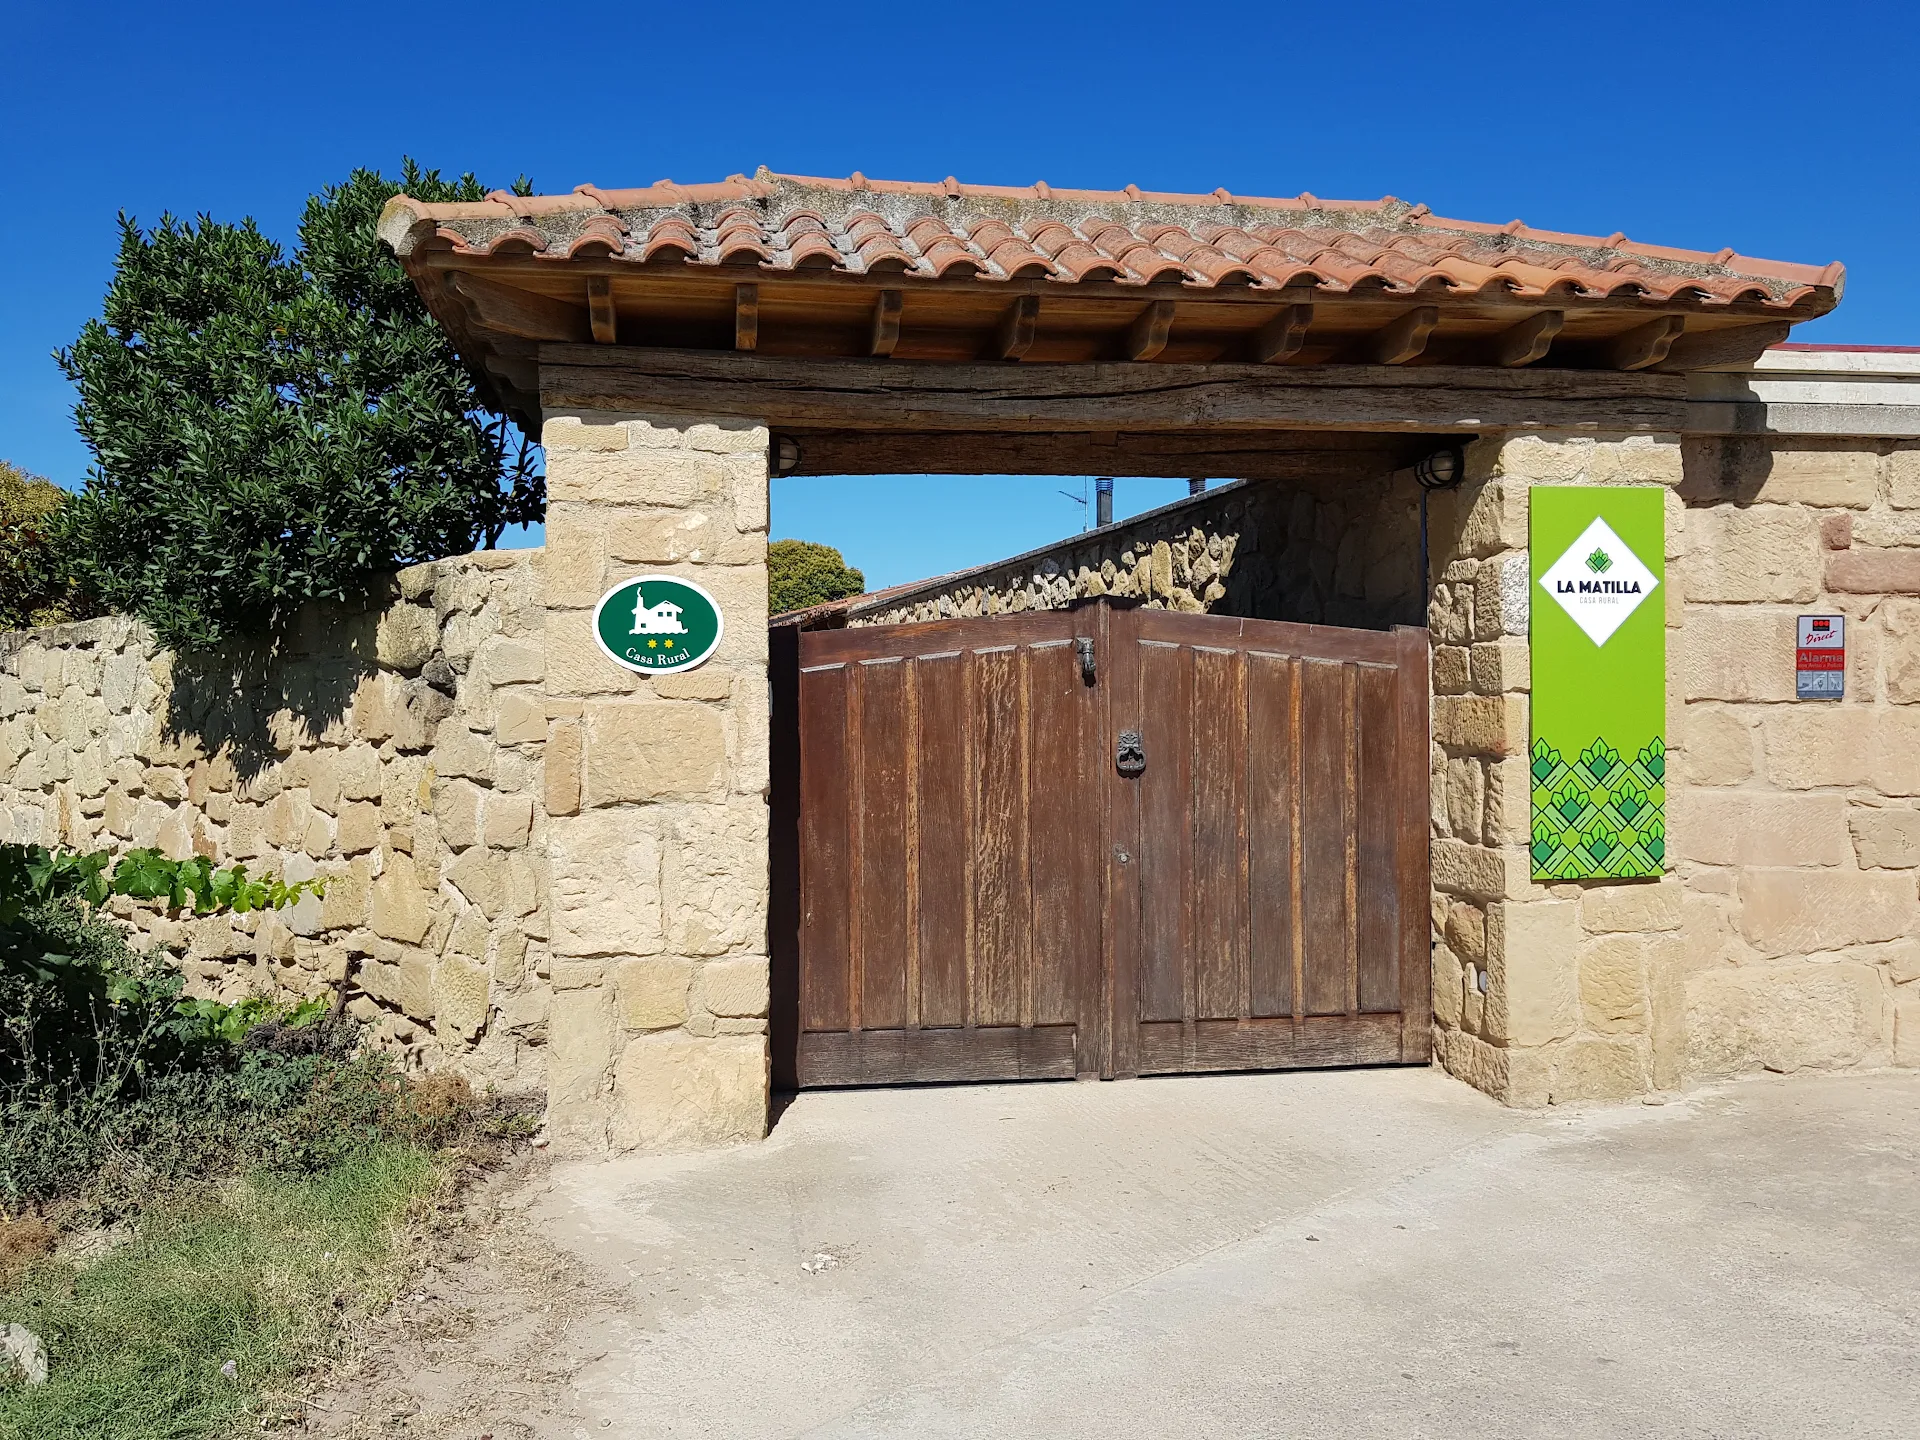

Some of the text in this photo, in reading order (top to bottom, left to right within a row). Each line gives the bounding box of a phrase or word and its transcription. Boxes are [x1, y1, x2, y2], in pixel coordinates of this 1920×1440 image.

[1557, 580, 1642, 594] LA MATILLA
[1579, 596, 1620, 605] CASA RURAL
[1805, 629, 1838, 646] Direct
[626, 647, 691, 666] Casa Rural
[1799, 652, 1844, 663] Alarma
